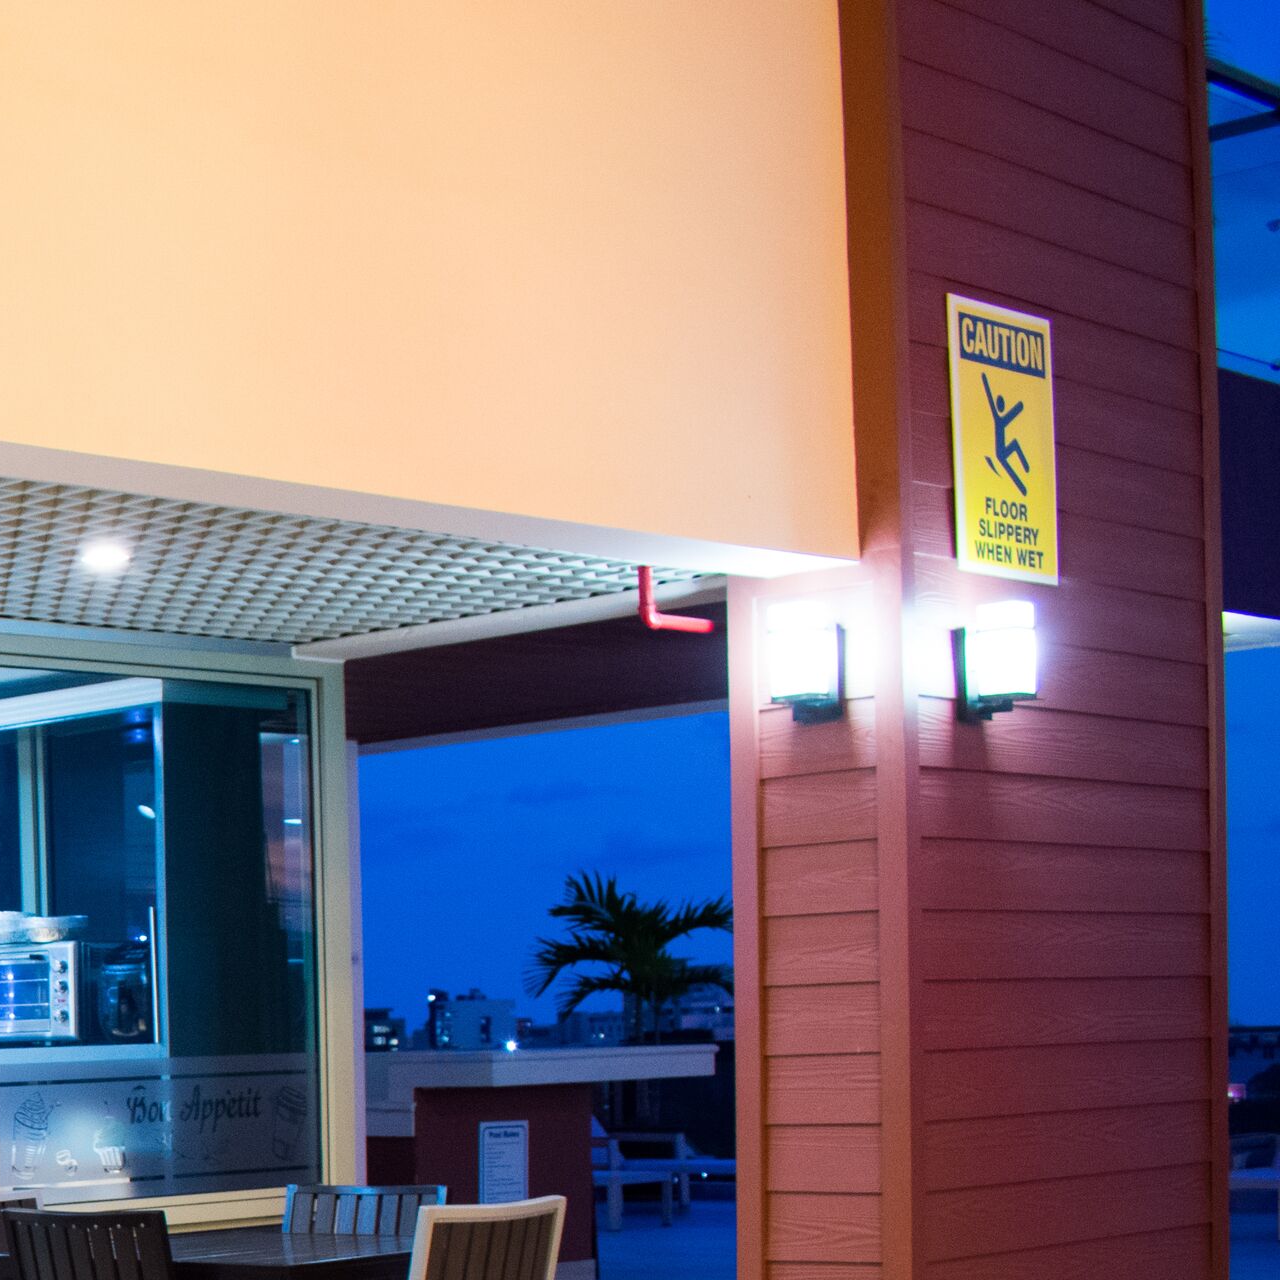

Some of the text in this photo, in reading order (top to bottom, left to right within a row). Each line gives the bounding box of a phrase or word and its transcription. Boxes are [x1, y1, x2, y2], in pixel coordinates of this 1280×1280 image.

[961, 317, 1043, 371] CAUTION
[985, 496, 1028, 522] FLOOR
[979, 518, 1039, 546] SLIPPERY
[975, 540, 1044, 569] WHEN WET
[127, 1085, 172, 1124] Bon
